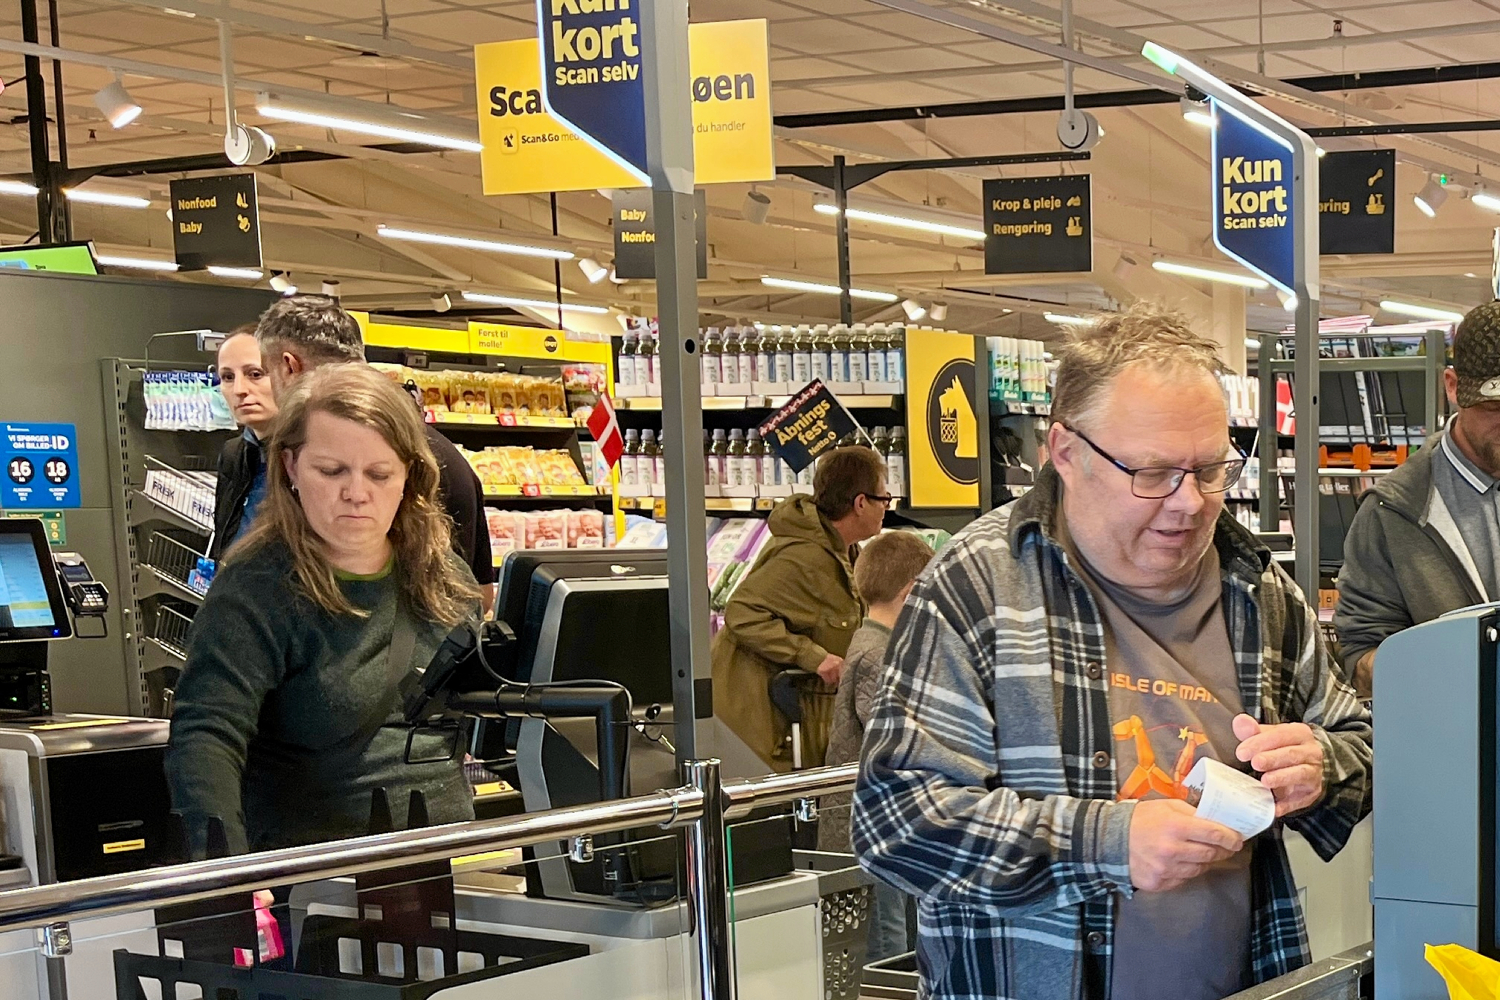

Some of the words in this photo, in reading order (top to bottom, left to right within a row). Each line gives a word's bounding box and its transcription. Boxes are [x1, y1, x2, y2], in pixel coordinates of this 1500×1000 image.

[552, 17, 640, 63] kort
[555, 66, 599, 86] Scan
[602, 61, 640, 82] selv
[489, 86, 548, 117] Sca
[691, 73, 755, 102] øen
[696, 122, 709, 133] du
[710, 120, 746, 132] handler
[521, 133, 560, 144] Scan&Go
[1222, 156, 1282, 185] Kun
[178, 196, 217, 210] Nonfood
[992, 199, 1021, 212] Krop
[1022, 198, 1032, 210] &
[1033, 195, 1062, 212] pleje
[1222, 185, 1288, 215] kort
[620, 208, 647, 222] Baby
[1223, 216, 1257, 230] Scan
[1258, 214, 1287, 227] selv
[179, 221, 203, 234] Baby
[993, 220, 1053, 237] Rengøring
[621, 230, 655, 243] Nonfo
[500, 330, 509, 338] til
[774, 399, 831, 447] Åbnings
[797, 419, 828, 446] fest
[10, 461, 32, 477] 16
[46, 461, 67, 477] 18
[152, 481, 175, 499] FRISK
[1110, 672, 1150, 693] ISLE
[1152, 680, 1178, 696] OF
